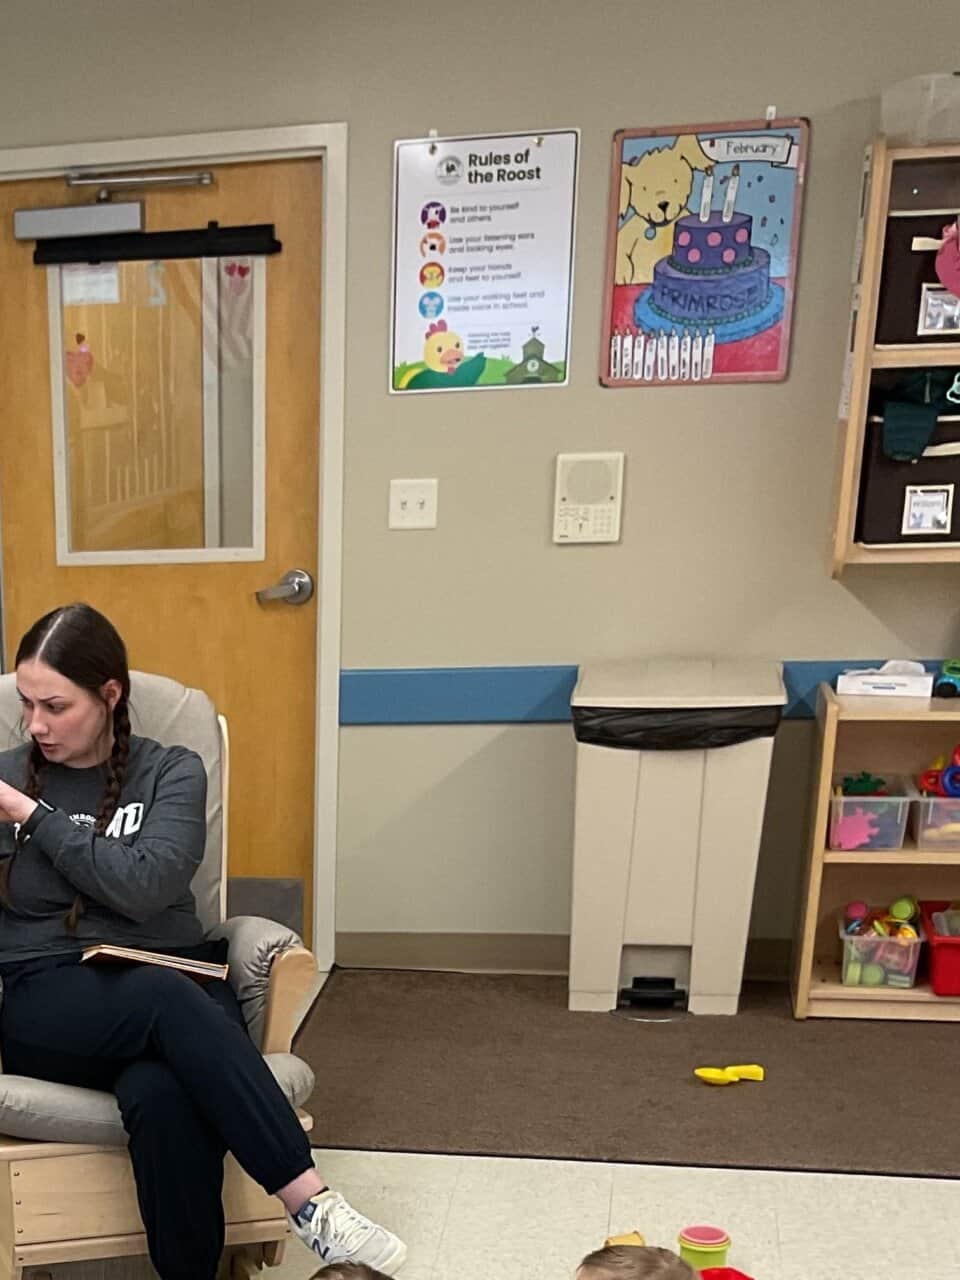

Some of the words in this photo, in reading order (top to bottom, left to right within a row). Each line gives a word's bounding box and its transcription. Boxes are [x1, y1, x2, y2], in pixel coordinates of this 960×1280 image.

[726, 140, 779, 156] February
[468, 151, 511, 167] Rules
[514, 148, 530, 164] of
[468, 170, 494, 184] the
[497, 166, 542, 182] Roost
[661, 285, 758, 313] PRIMROSE
